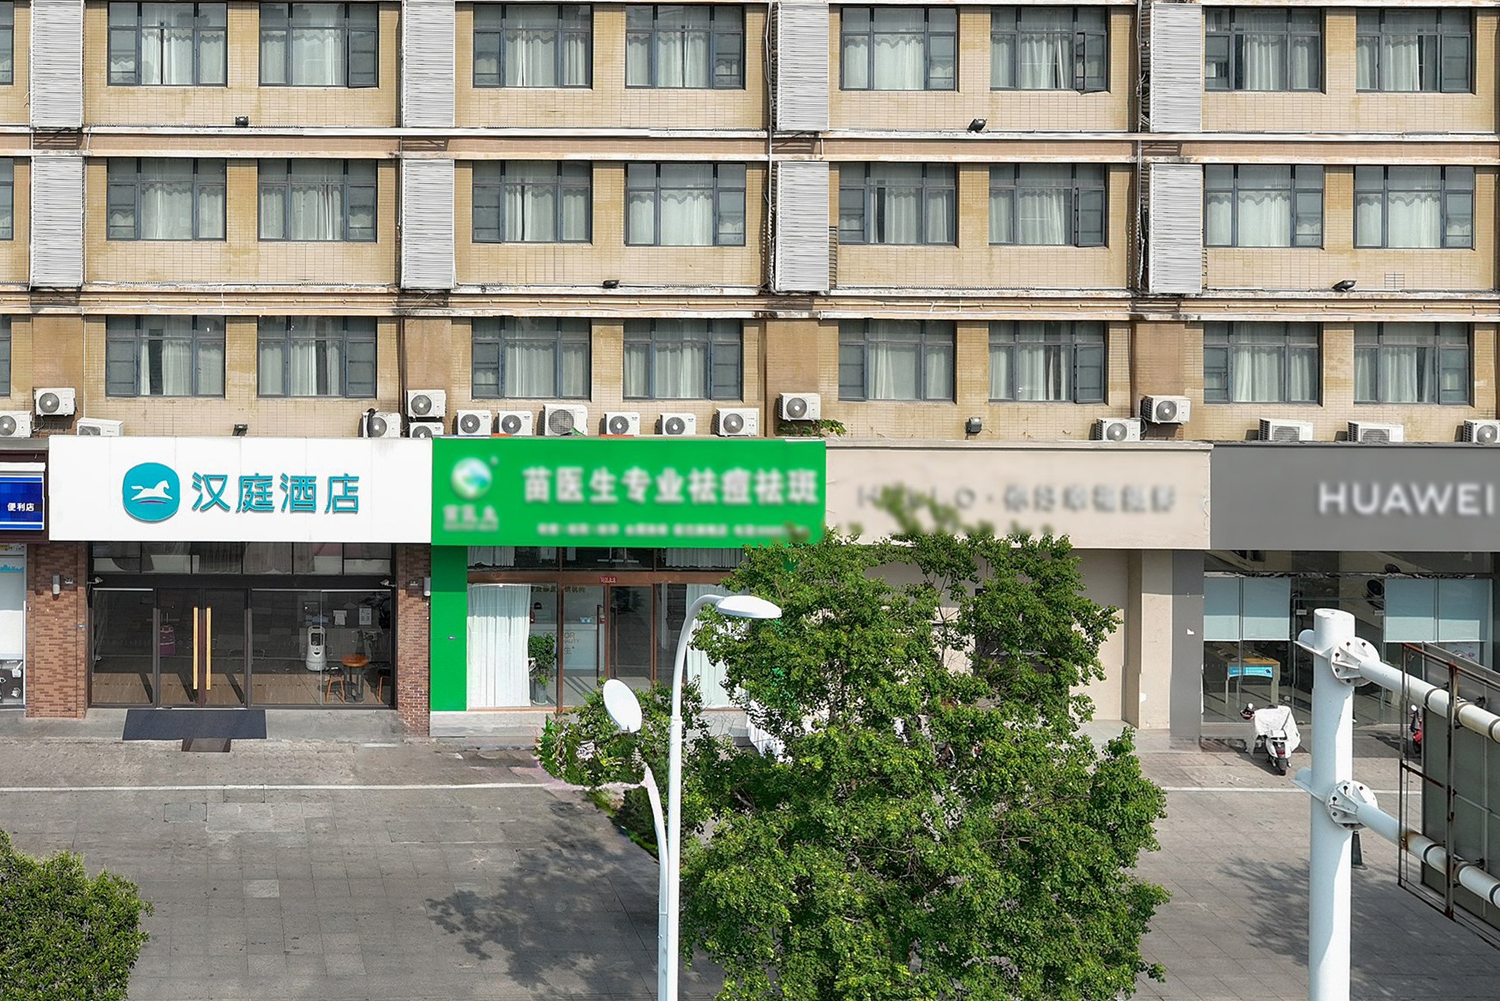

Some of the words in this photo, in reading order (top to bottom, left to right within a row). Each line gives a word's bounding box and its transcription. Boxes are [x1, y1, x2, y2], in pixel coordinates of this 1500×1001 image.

[7, 502, 34, 512] 便利店
[192, 472, 360, 514] 汉庭酒店
[1318, 481, 1495, 516] HUAWEI
